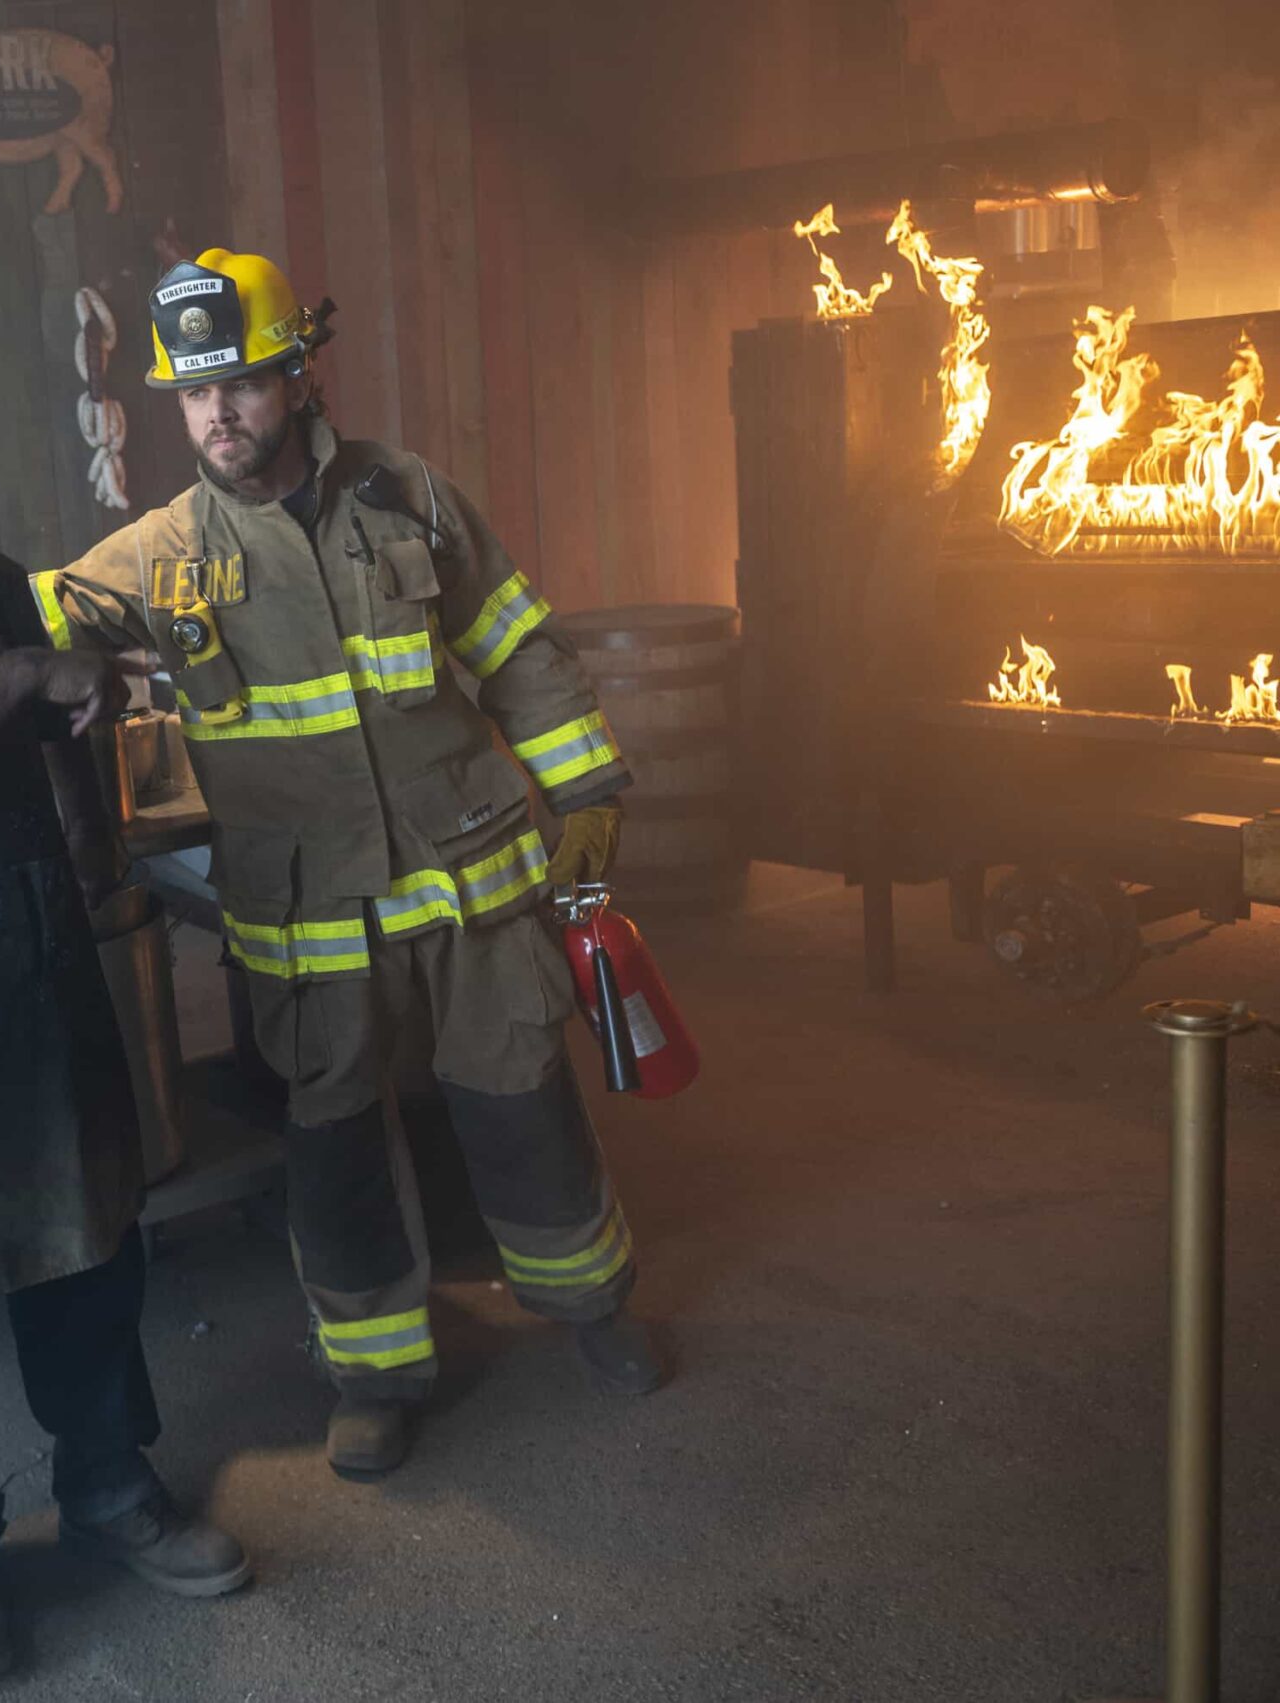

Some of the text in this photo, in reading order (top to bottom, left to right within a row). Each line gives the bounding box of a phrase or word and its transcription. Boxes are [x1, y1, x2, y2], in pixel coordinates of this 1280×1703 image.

[161, 281, 217, 301] FIREFIGHTER
[184, 352, 227, 369] CAL FIRE
